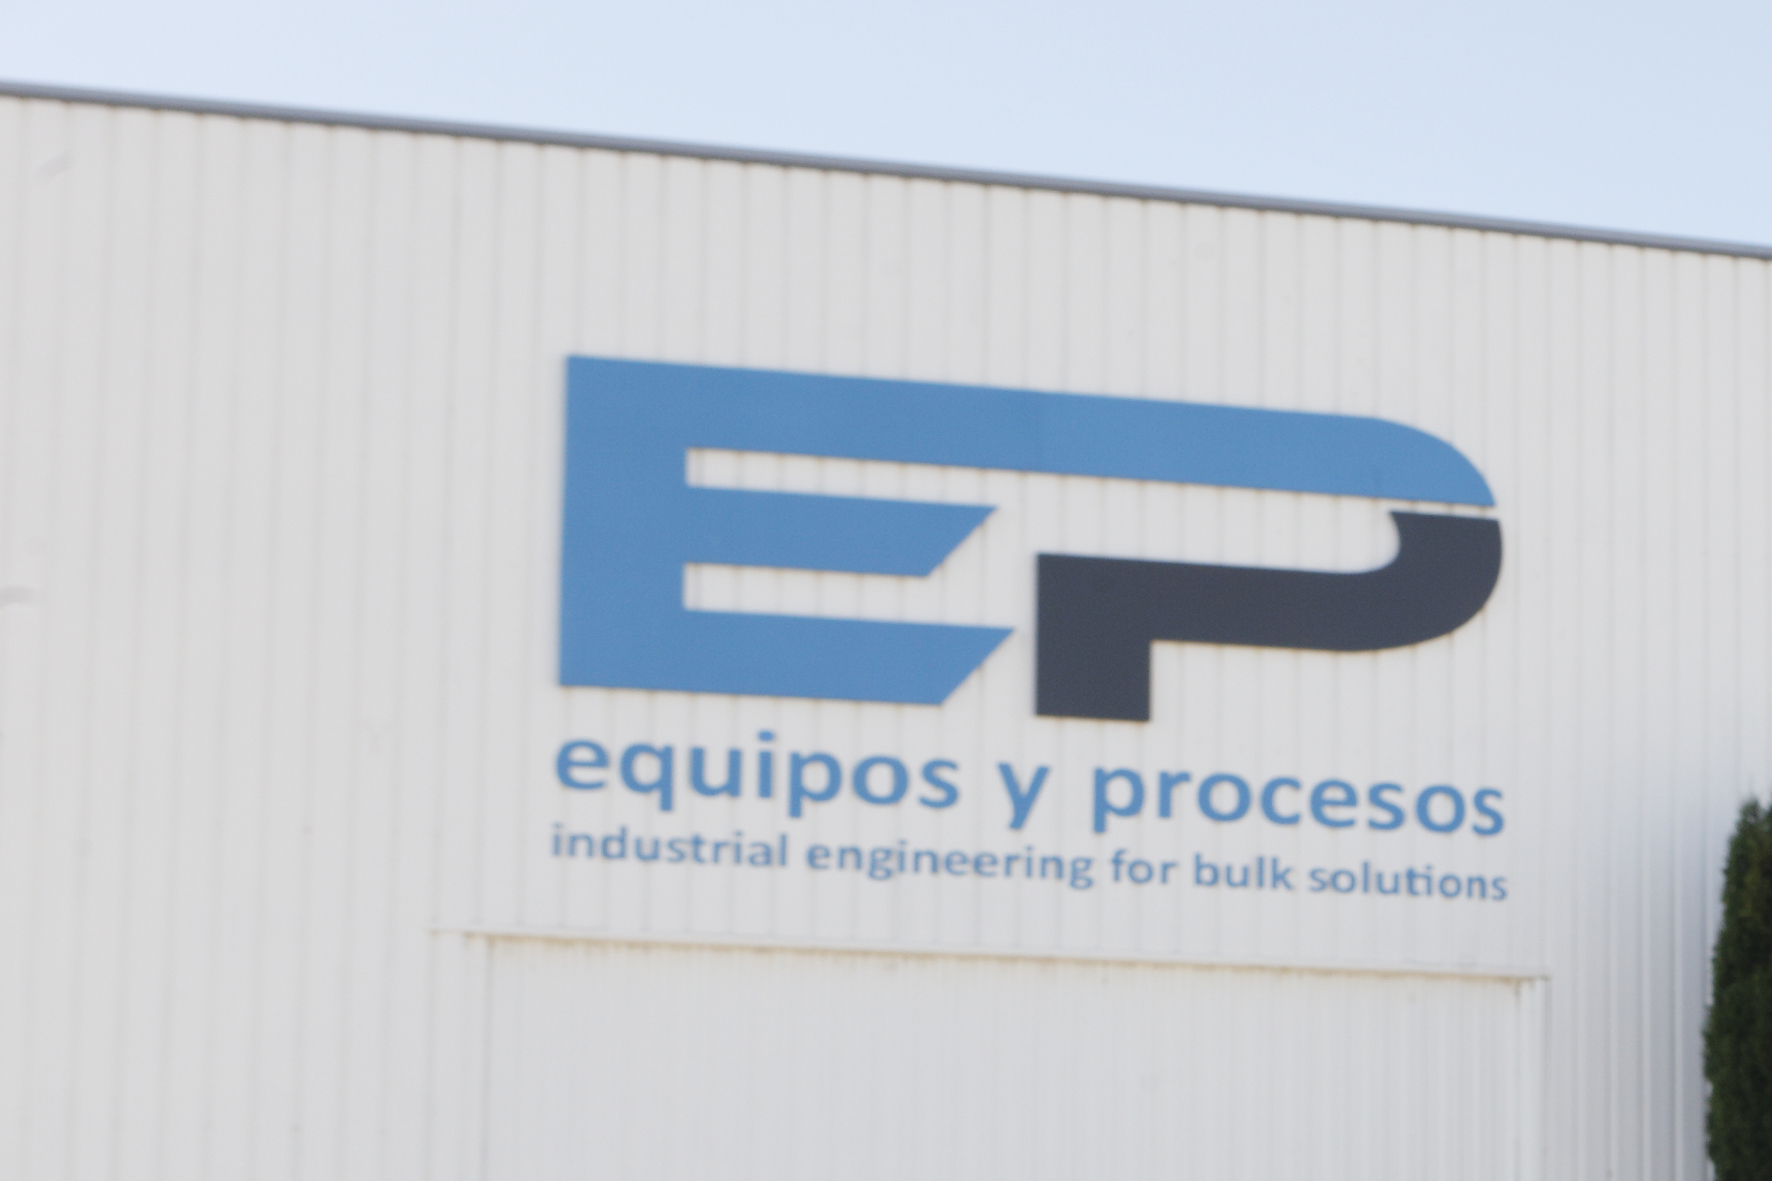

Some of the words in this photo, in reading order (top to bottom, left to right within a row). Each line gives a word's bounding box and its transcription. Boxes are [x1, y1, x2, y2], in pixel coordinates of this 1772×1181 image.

[559, 355, 1503, 723] EP
[555, 730, 960, 818] equipos
[997, 762, 1050, 829] y
[1092, 767, 1506, 837] procesos
[551, 822, 787, 869] industrial
[806, 837, 1095, 890] engineering
[1111, 847, 1182, 887] for
[1193, 853, 1295, 894] bulk
[1307, 860, 1508, 902] solutions
